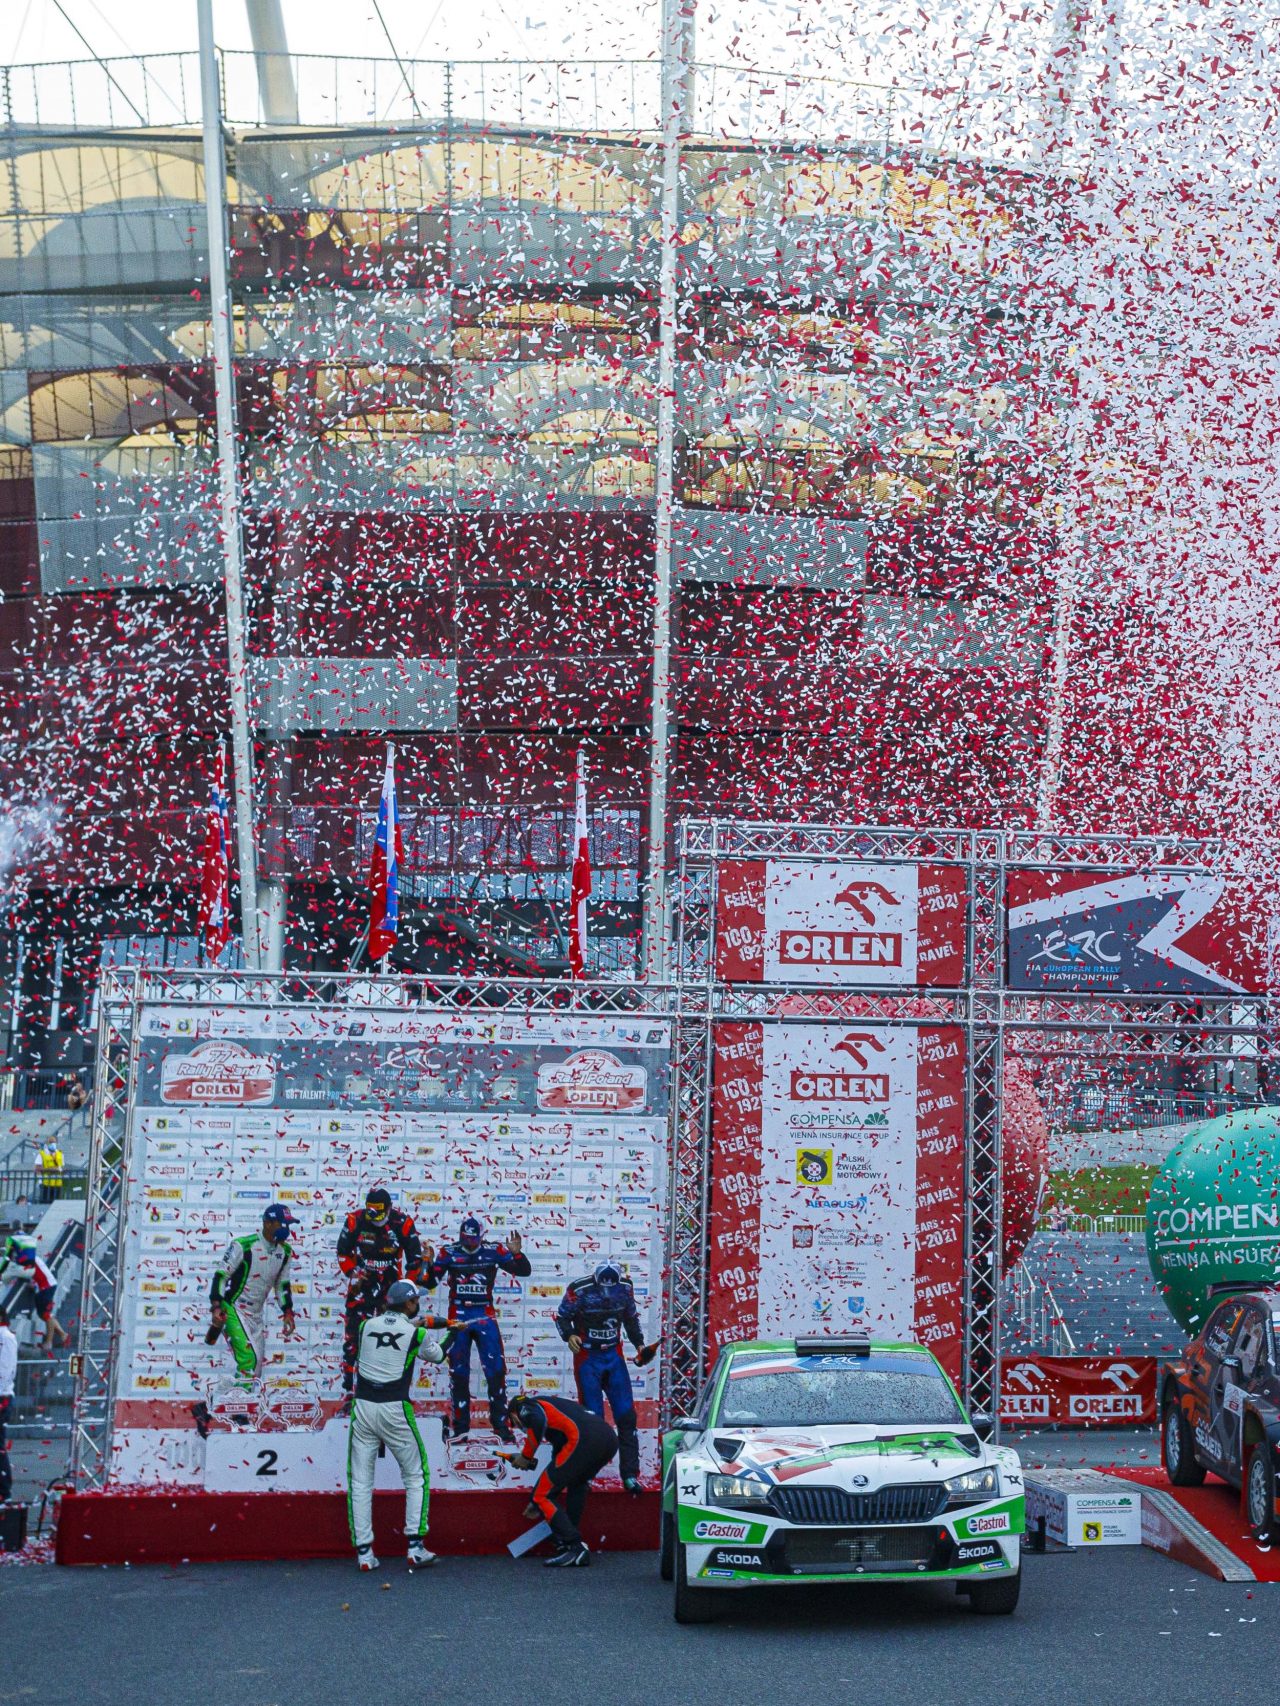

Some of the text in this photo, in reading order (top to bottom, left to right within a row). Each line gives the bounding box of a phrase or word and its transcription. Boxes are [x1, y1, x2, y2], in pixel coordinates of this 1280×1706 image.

[723, 926, 752, 949] 100
[785, 935, 895, 961] ORLEN
[1044, 964, 1090, 973] EUROPEAN
[1042, 973, 1120, 981] CHAMPIONSHIP
[720, 1041, 752, 1061] FEEL
[178, 1062, 261, 1077] Rally Poland
[194, 1085, 240, 1095] ORLEN
[720, 1079, 750, 1100] 100
[795, 1077, 886, 1098] ORLEN
[790, 1113, 861, 1125] COMPENSA
[719, 1172, 750, 1195] 100
[718, 1266, 747, 1288] 100
[458, 1285, 486, 1293] ORLEN
[591, 1330, 617, 1340] ORLEN
[1074, 1398, 1137, 1414] ORLEN
[256, 1449, 278, 1476] 2
[467, 1460, 488, 1469] ORLEN
[1077, 1499, 1117, 1507] COMPENSA
[707, 1523, 746, 1539] Castrol
[978, 1514, 1007, 1532] Castrol
[717, 1551, 762, 1566] ŠKODA
[958, 1544, 995, 1560] ŠKODA
